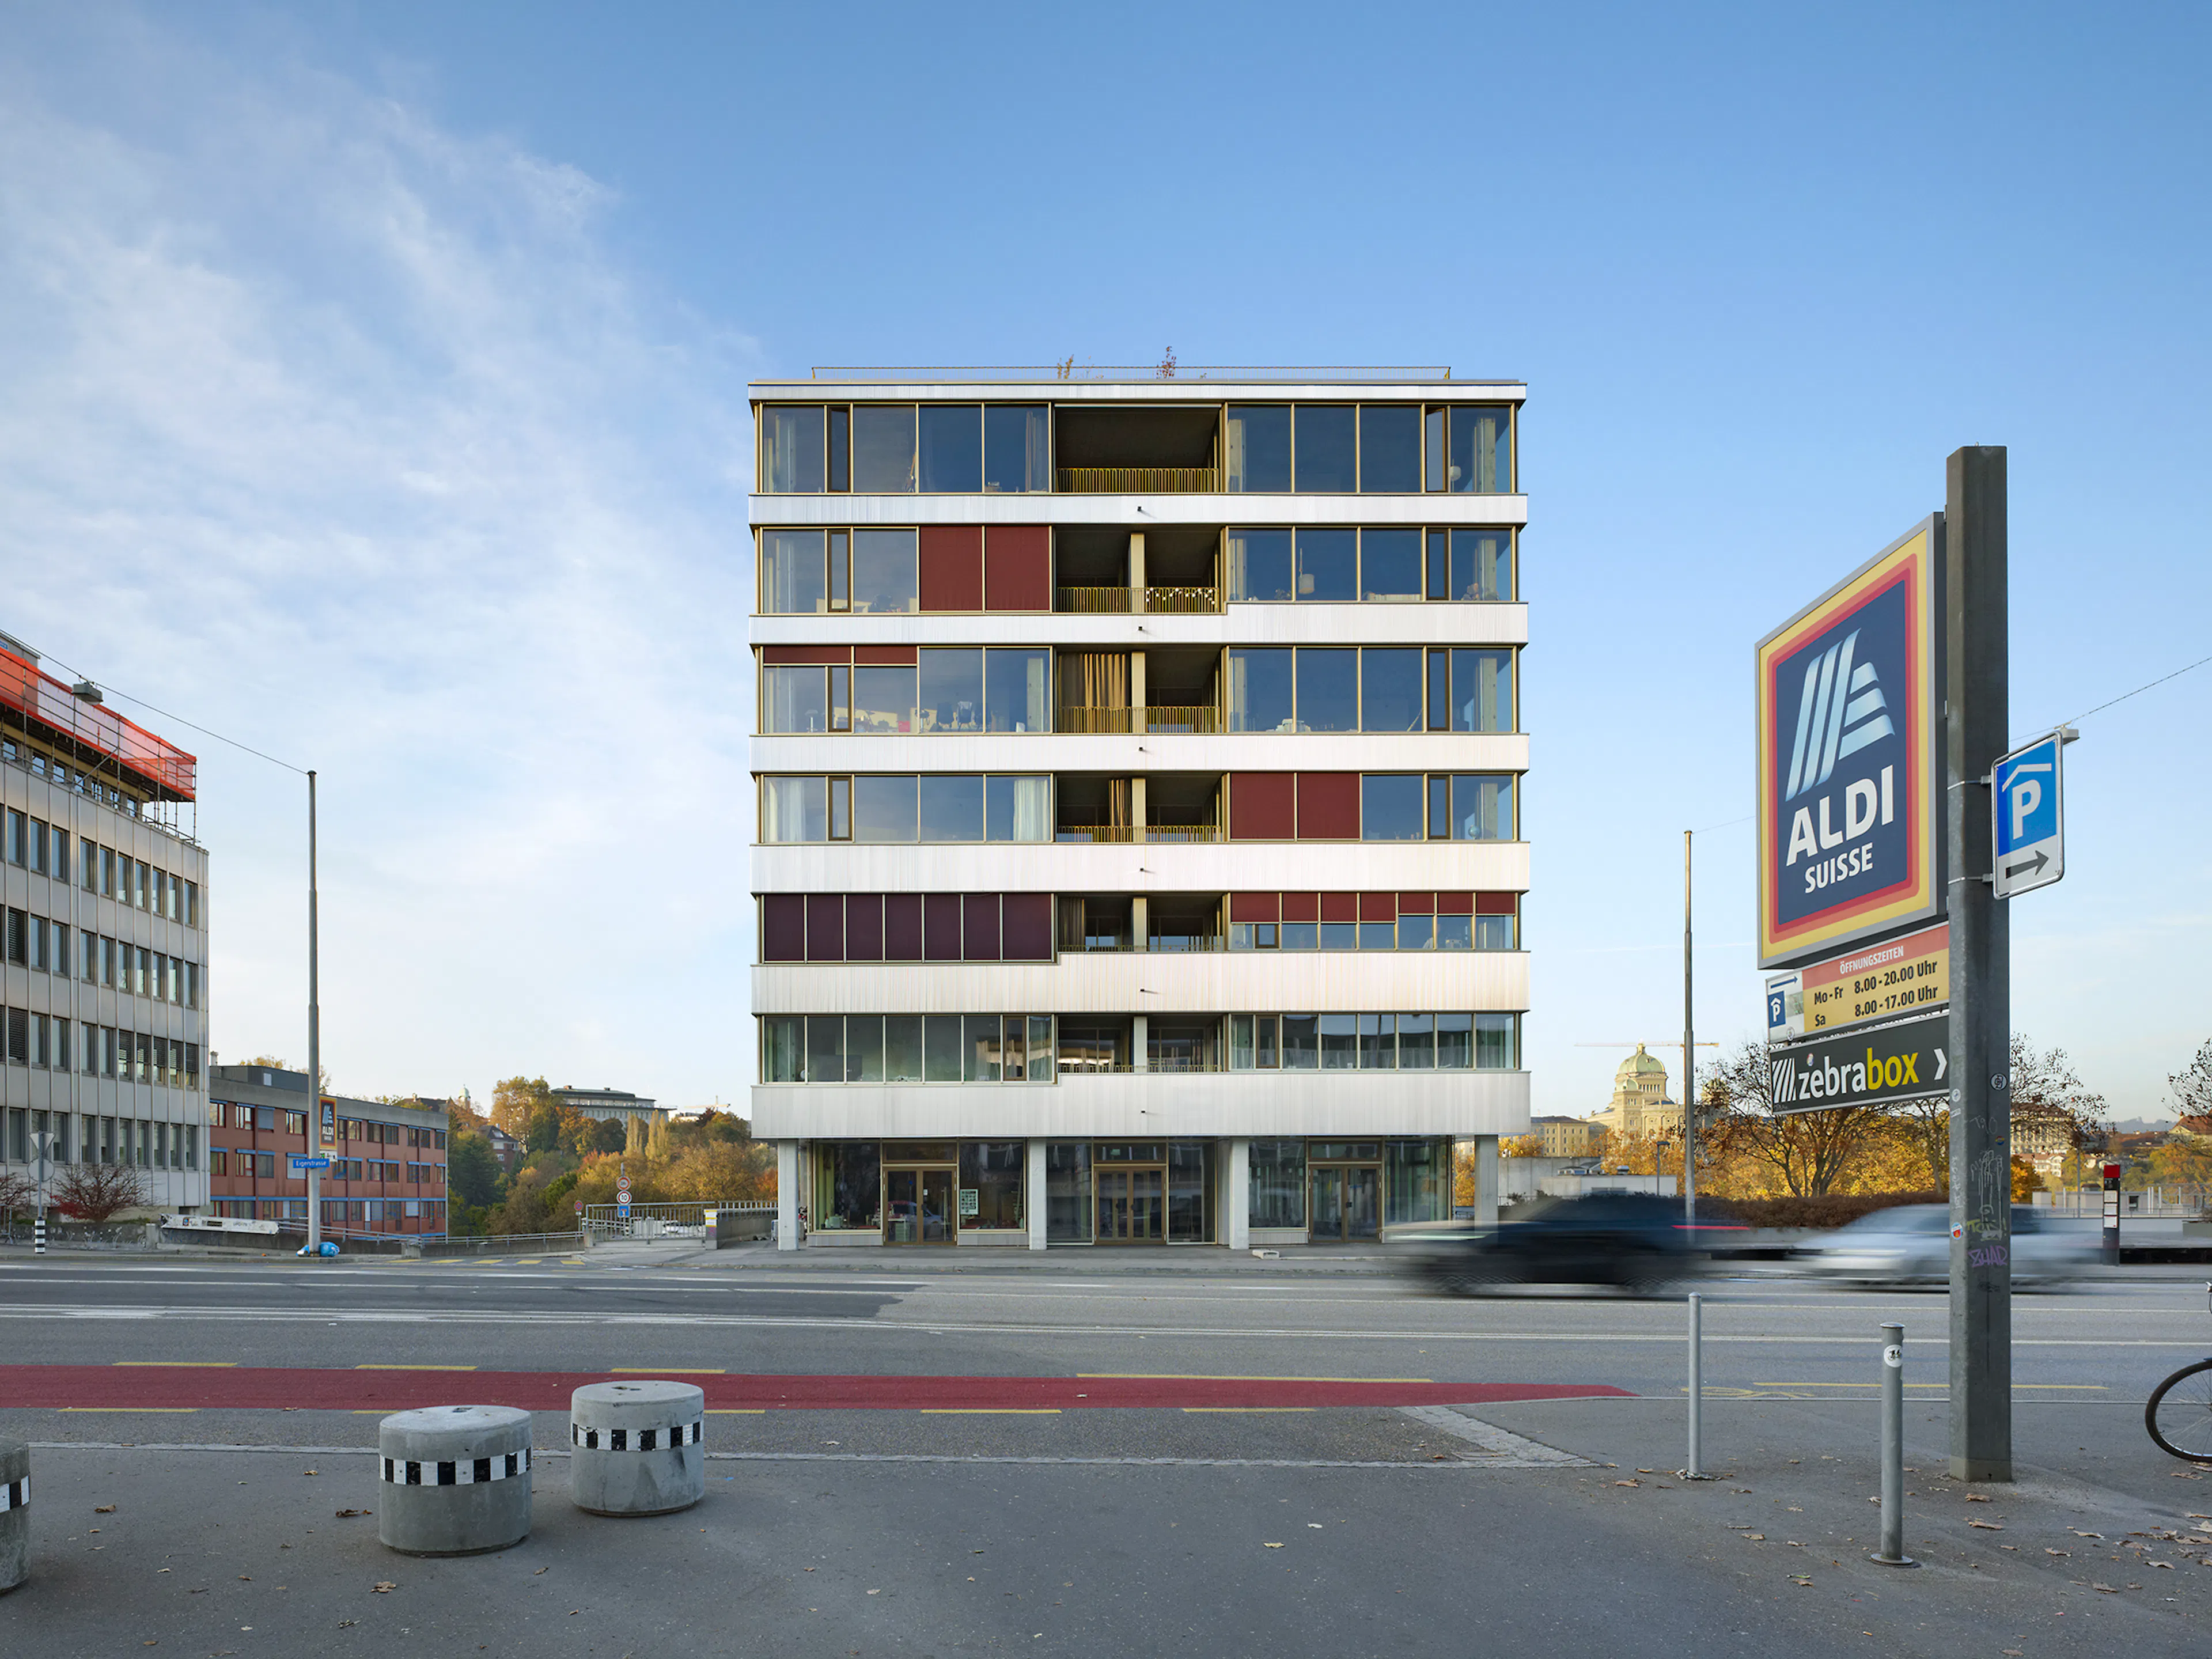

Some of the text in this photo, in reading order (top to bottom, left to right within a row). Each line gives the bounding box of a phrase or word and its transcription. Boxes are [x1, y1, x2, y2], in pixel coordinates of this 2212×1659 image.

[1786, 764, 1893, 866] ALDI
[2012, 779, 2041, 840] P
[1805, 842, 1873, 894] SUISSE
[1839, 945, 1904, 975] ÖFFNUNGSZEITEN
[1917, 960, 1937, 977] Uhr
[1815, 1014, 1826, 1027] Sa
[1918, 985, 1938, 1002] Uhr
[1798, 1047, 1919, 1100] zebrabox
